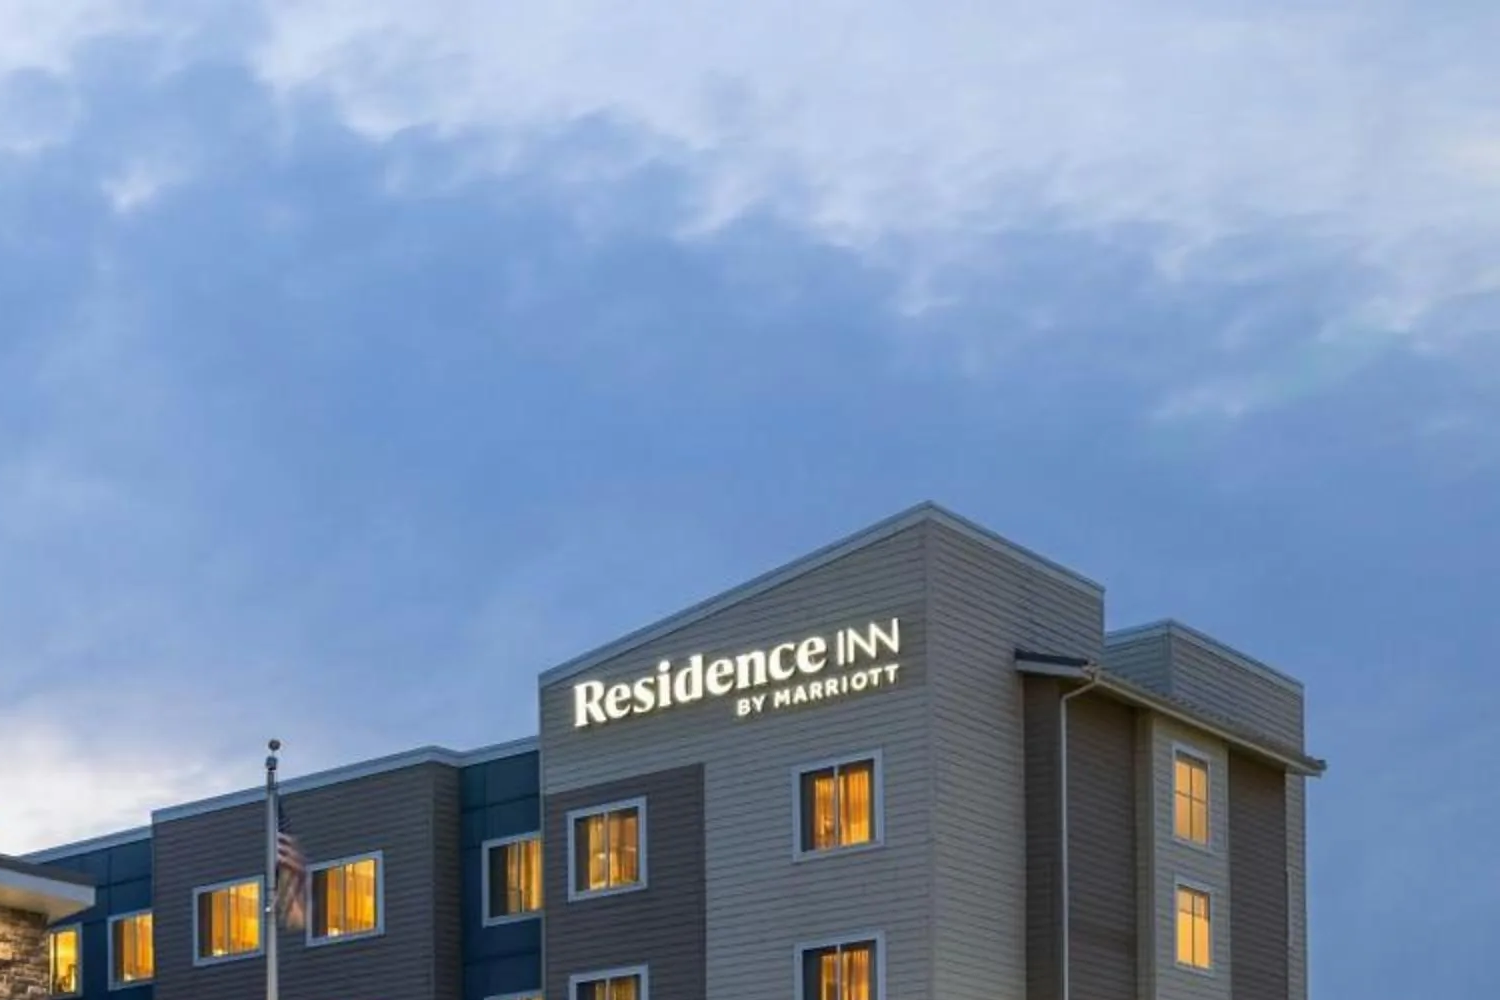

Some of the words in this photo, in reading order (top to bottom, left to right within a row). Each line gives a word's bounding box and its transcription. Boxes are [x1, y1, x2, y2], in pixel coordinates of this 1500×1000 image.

[573, 635, 827, 727] Residence
[837, 618, 900, 665] INN
[737, 696, 765, 717] BY
[774, 664, 899, 708] MARRIOTT
